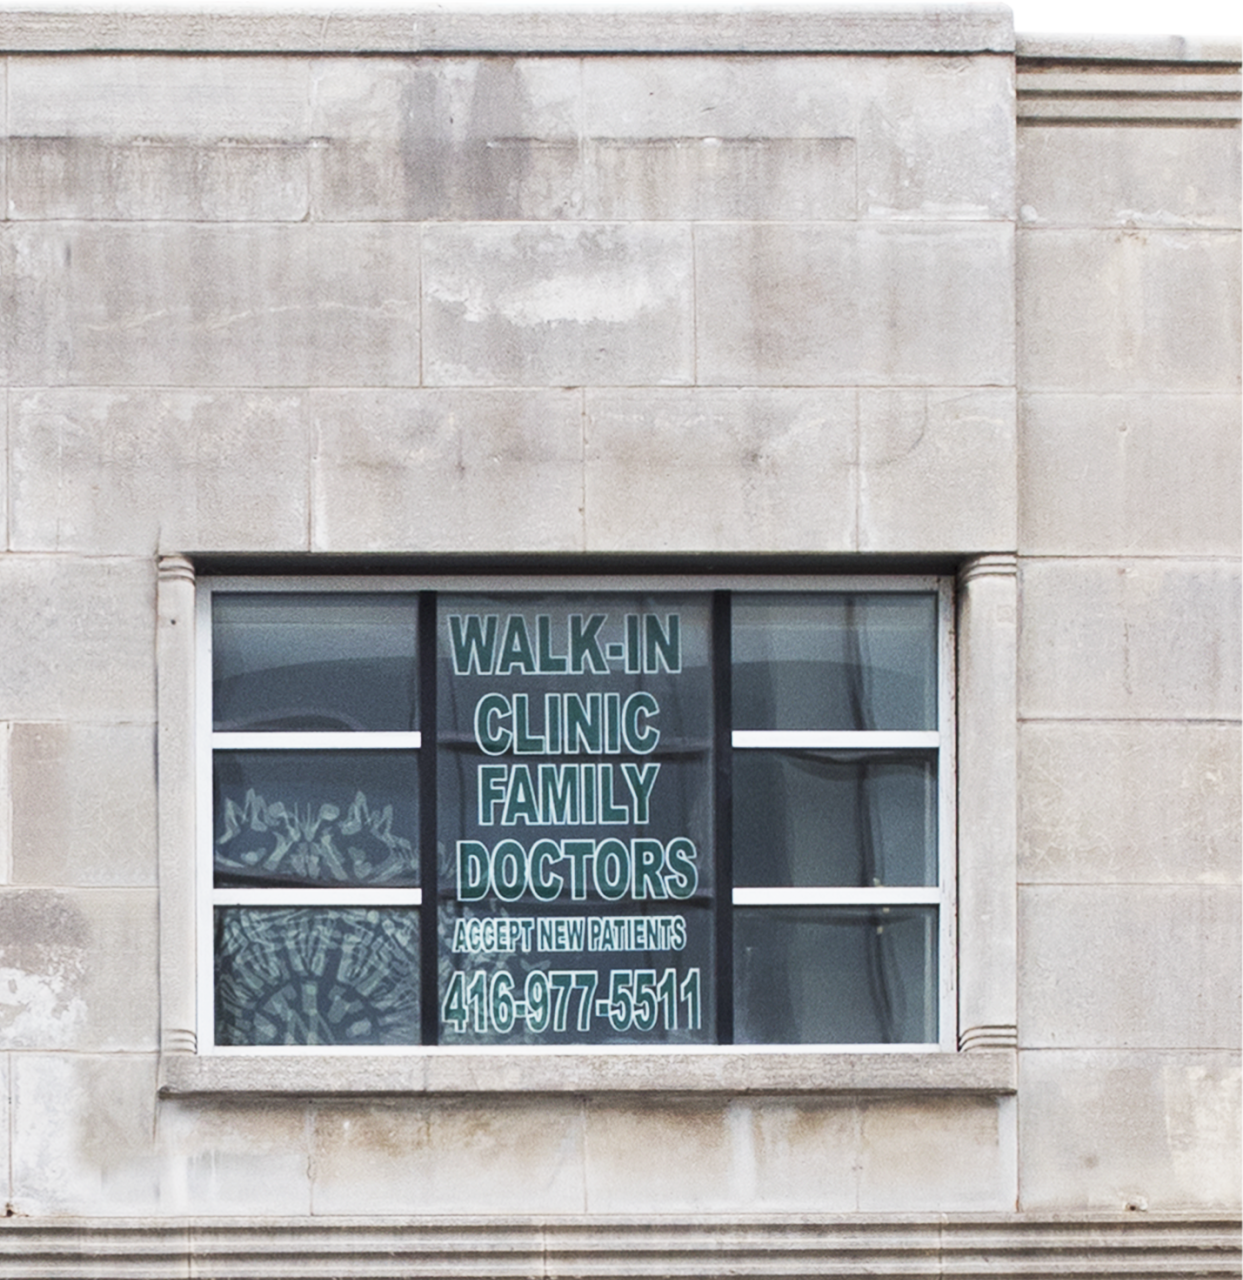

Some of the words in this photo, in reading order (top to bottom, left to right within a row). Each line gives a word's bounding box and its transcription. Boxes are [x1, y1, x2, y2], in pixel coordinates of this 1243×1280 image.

[448, 614, 682, 675] WALK-IN
[474, 691, 660, 755] CLINIC
[478, 763, 661, 826] FAMILY
[457, 837, 698, 902] DOCTORS
[453, 917, 534, 952] ACCEPT
[538, 917, 585, 951] NEW
[588, 915, 687, 951] PATIENTS
[442, 968, 701, 1033] 416-977-5511
